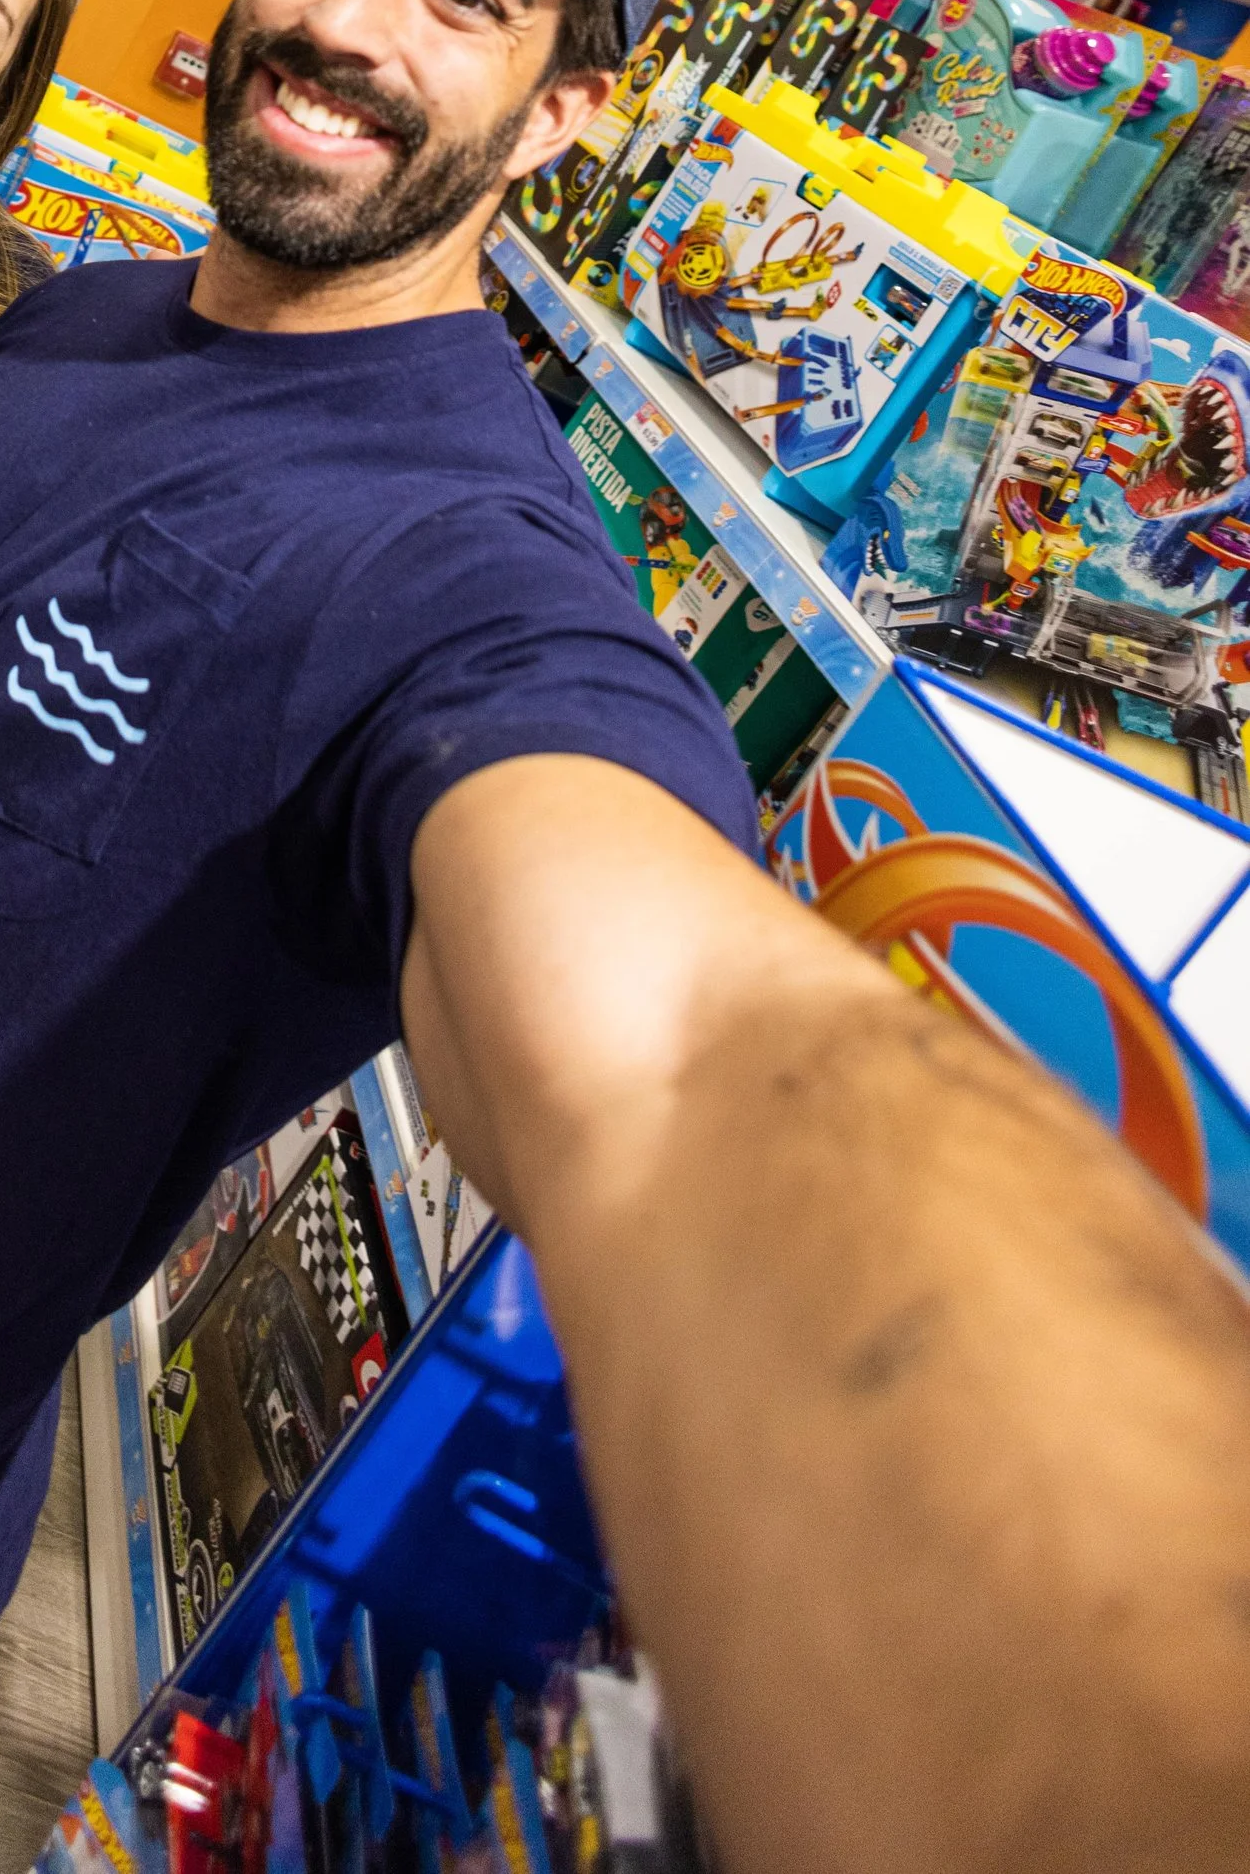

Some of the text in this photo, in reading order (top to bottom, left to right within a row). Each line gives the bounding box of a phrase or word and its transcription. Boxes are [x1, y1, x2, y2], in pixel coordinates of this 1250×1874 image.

[1029, 256, 1073, 293] HOT
[582, 402, 624, 456] PISTA
[568, 425, 633, 514] DIVERTIDA
